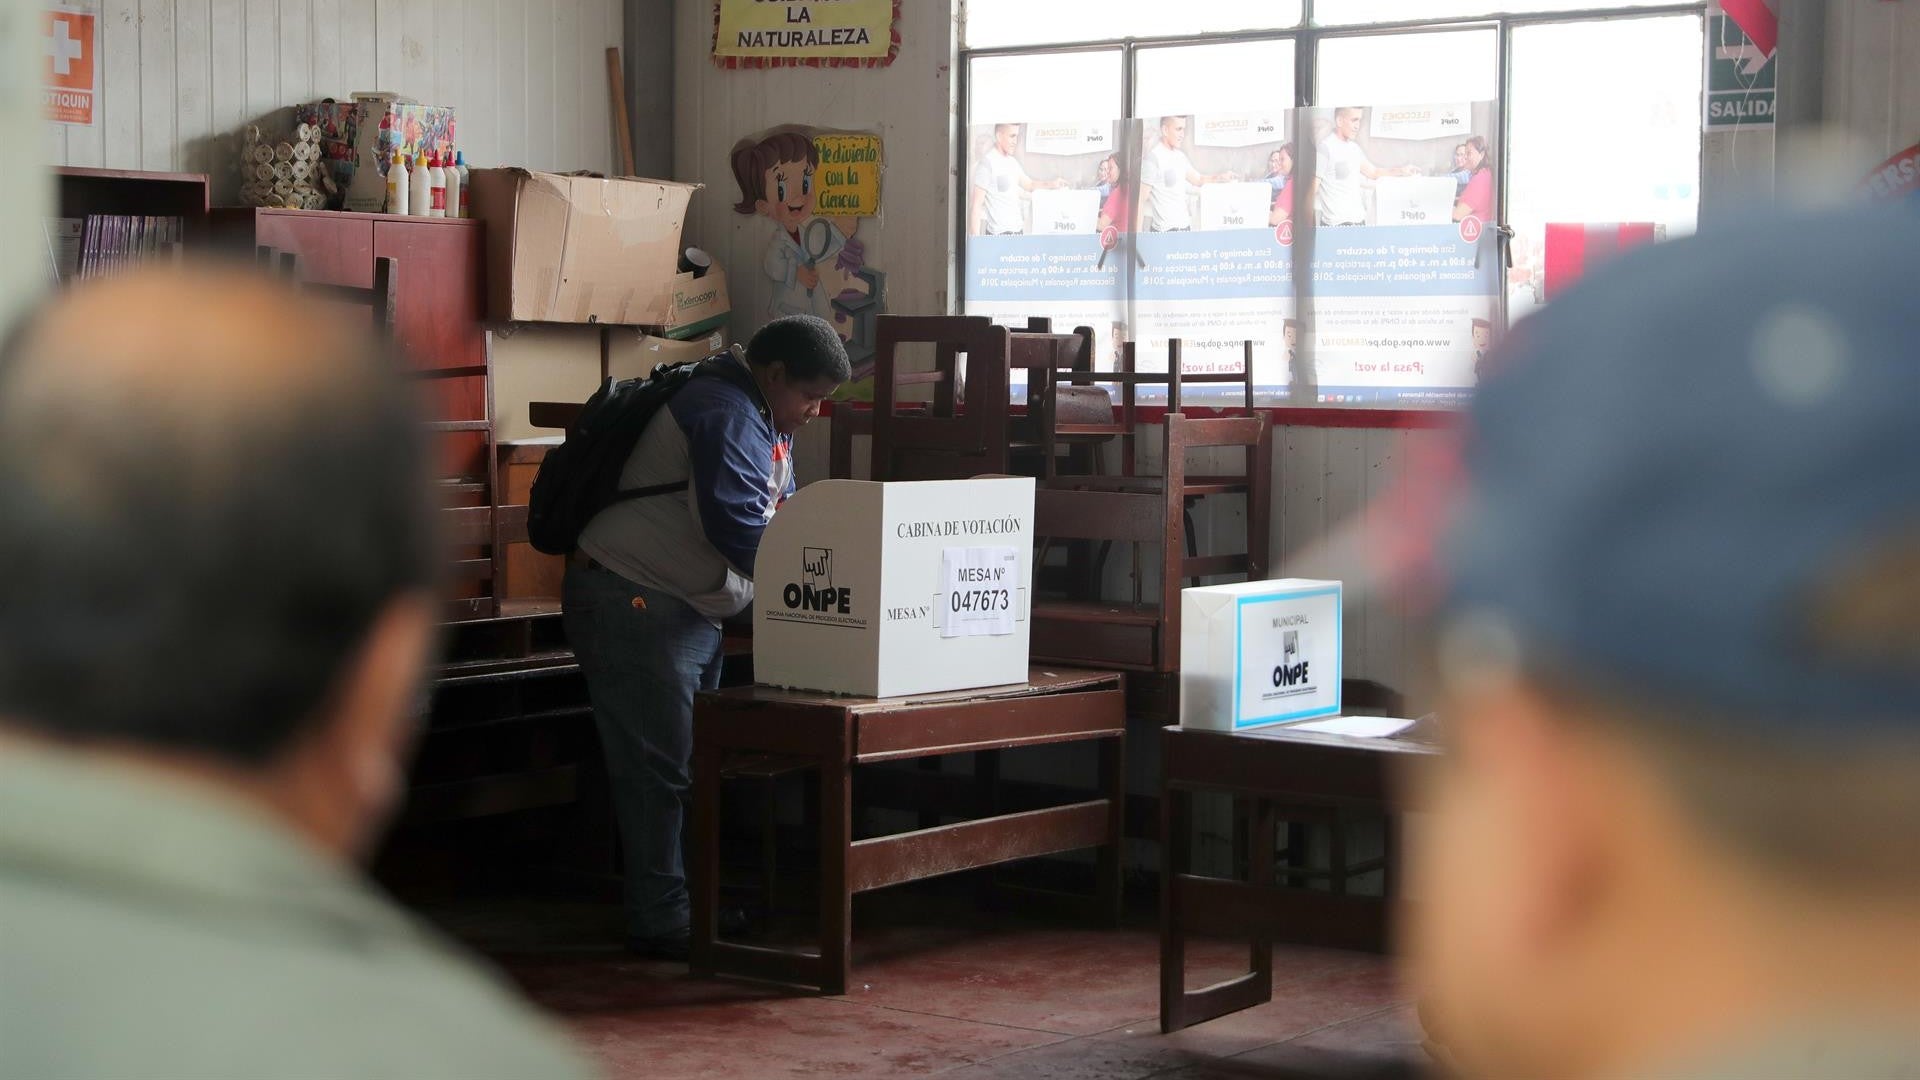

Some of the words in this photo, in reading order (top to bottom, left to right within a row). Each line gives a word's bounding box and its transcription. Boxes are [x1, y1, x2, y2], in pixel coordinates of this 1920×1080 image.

[786, 6, 811, 23] LA
[738, 27, 870, 48] NATURALEZA
[825, 170, 844, 187] con
[847, 165, 859, 186] la
[897, 520, 942, 539] CABINA
[944, 519, 960, 537] DE
[962, 514, 1021, 535] VOTACIÓN
[958, 567, 991, 582] MESA
[783, 583, 851, 614] ONPE
[951, 589, 1009, 612] 047673
[785, 611, 807, 619] NACIONAL
[887, 607, 917, 621] MESA
[1272, 614, 1309, 628] MUNICIPAL
[1273, 661, 1309, 688] ONPE
